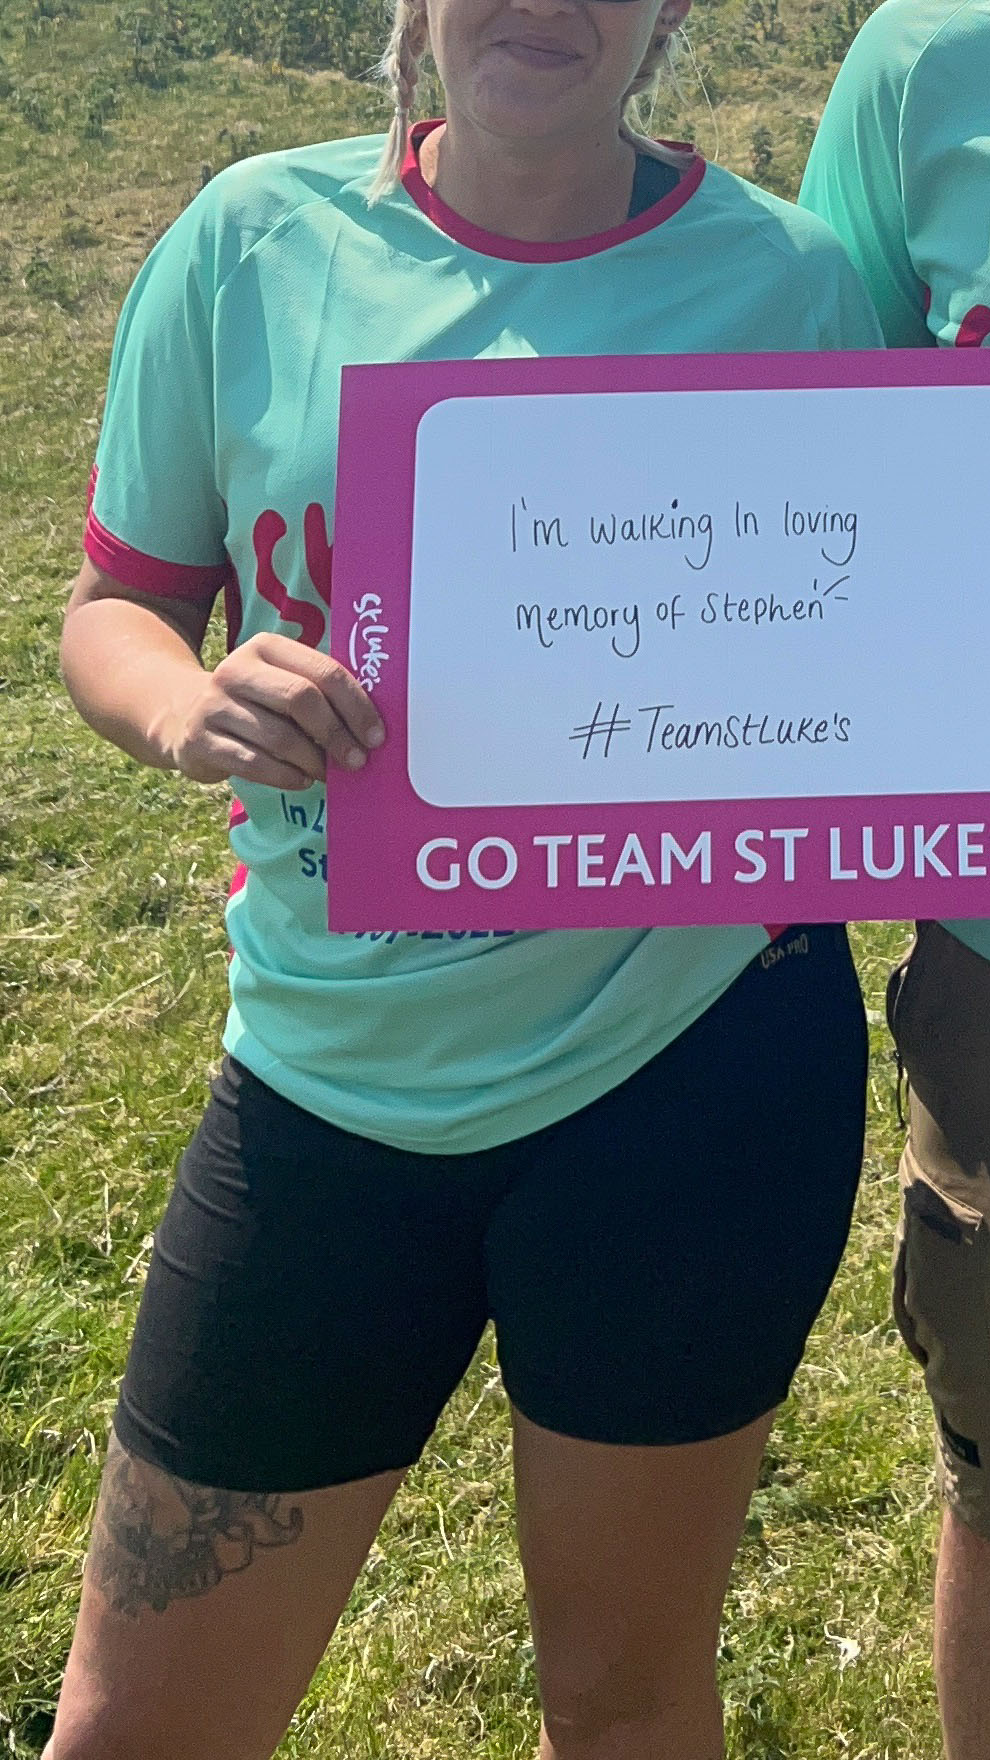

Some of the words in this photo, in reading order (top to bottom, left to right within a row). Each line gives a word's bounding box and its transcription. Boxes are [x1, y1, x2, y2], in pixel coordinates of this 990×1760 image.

[512, 497, 569, 552] I'm
[784, 501, 858, 566] loving
[656, 594, 685, 630] of
[281, 793, 308, 828] In
[415, 837, 518, 891] GO
[533, 830, 713, 888] TEAM
[733, 827, 810, 884] ST
